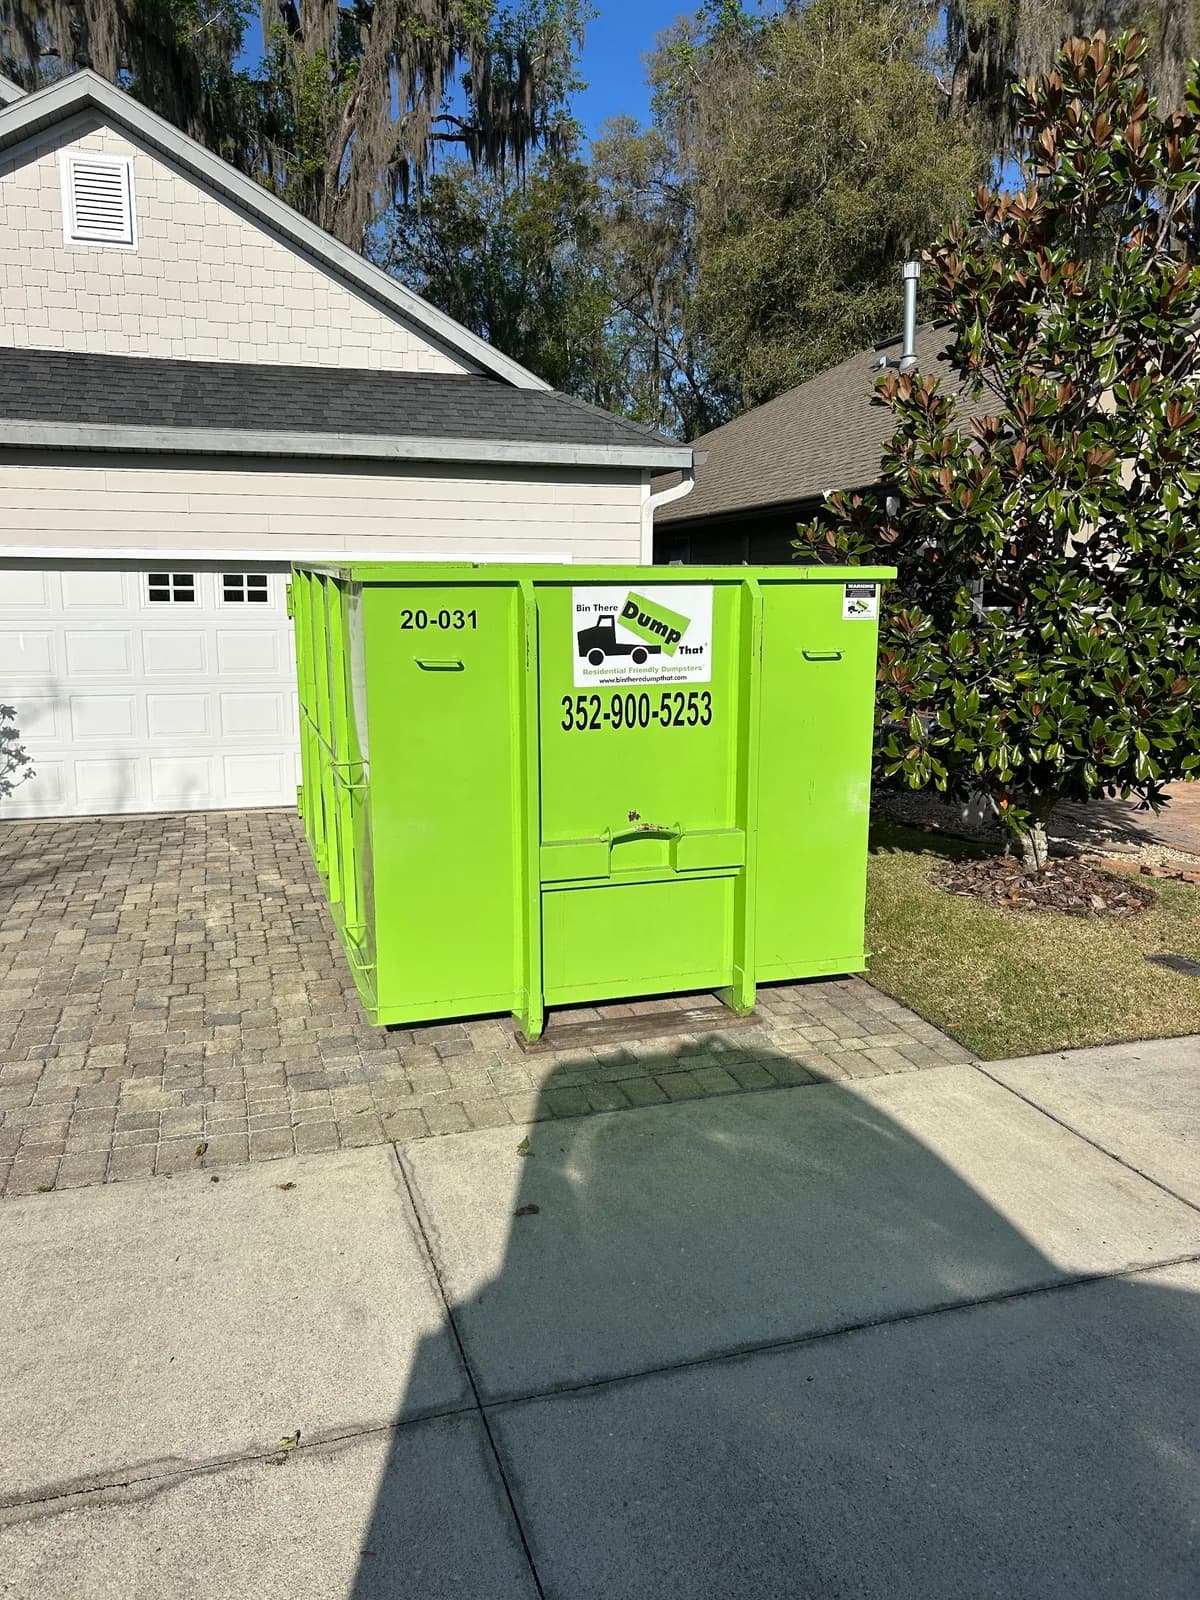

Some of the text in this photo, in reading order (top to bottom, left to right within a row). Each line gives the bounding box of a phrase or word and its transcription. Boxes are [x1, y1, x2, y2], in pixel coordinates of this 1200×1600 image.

[576, 604, 618, 612] Bin There
[401, 610, 477, 629] 20-031
[621, 601, 682, 644] Dump
[679, 645, 703, 655] That
[583, 665, 702, 675] Residential Friendly Dumpsters
[599, 675, 688, 683] www.bintheredumpthat.com
[561, 691, 712, 731] 352-900-5253
